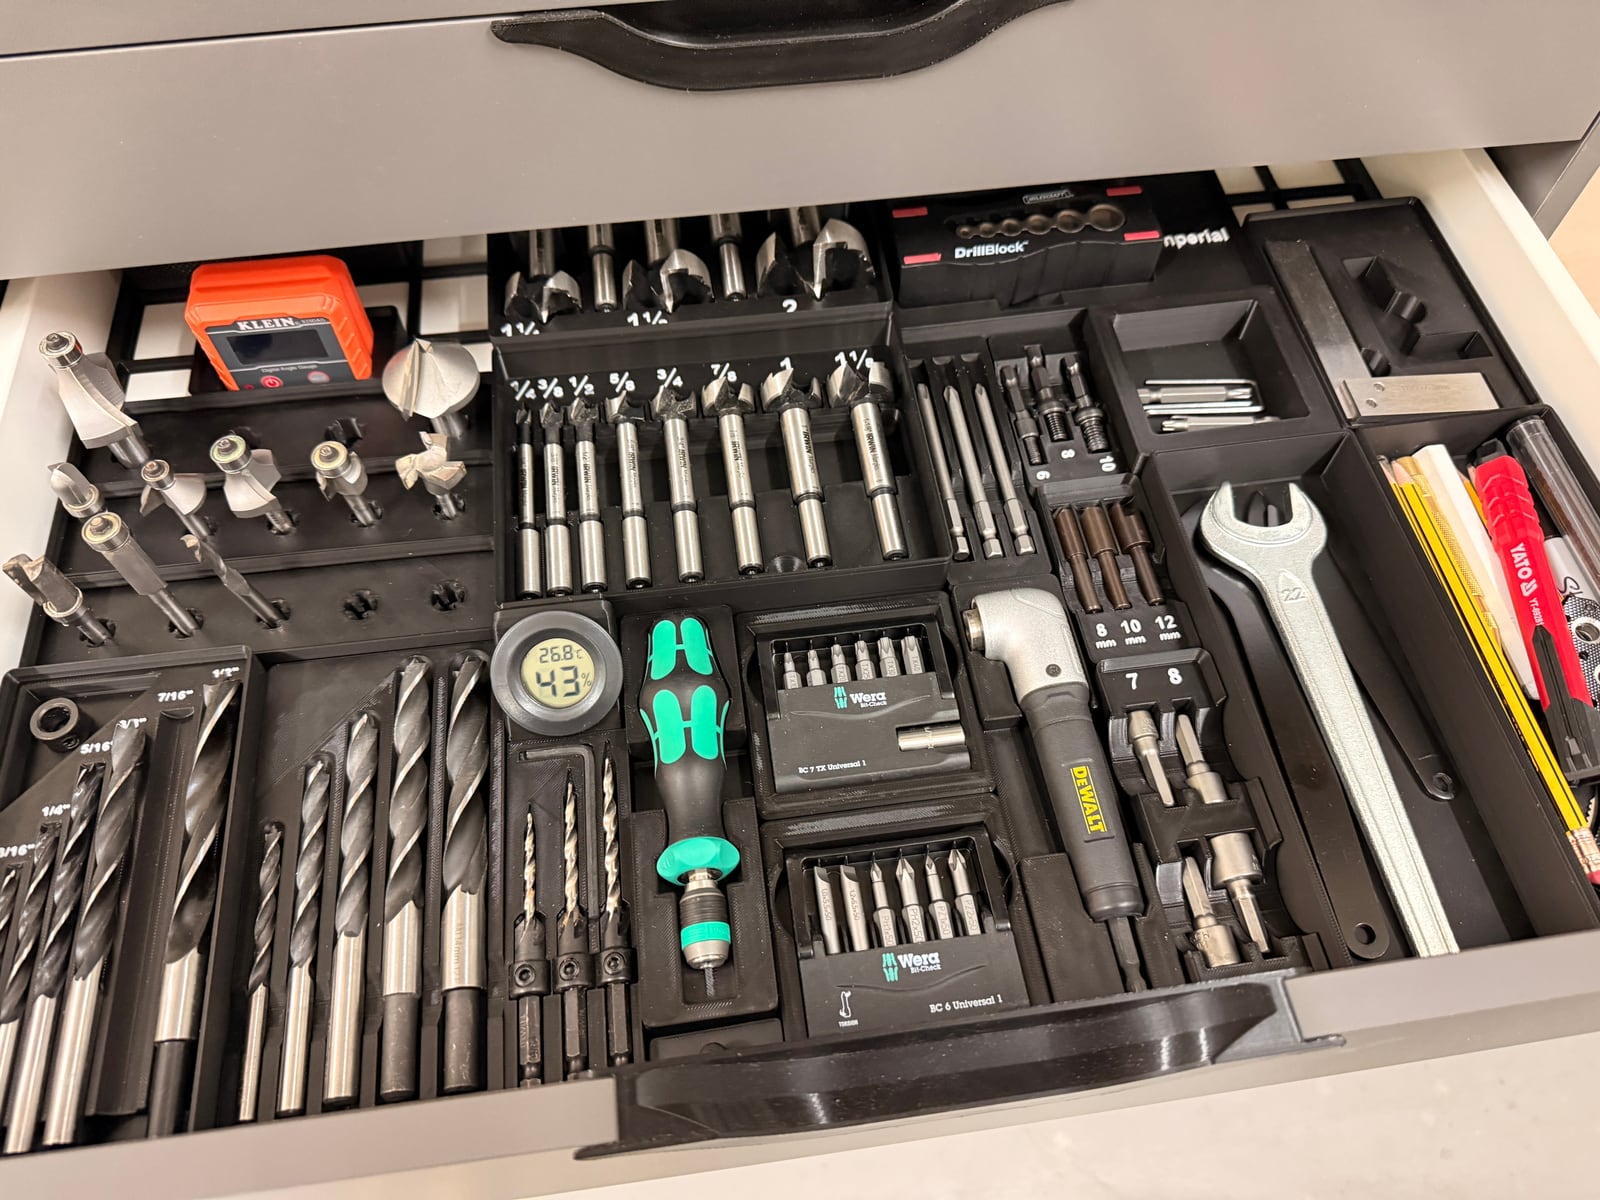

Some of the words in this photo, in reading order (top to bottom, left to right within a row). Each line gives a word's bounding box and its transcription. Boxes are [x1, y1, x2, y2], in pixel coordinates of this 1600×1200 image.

[954, 240, 1025, 259] DrillBlock
[237, 317, 295, 332] KLEIN
[656, 367, 683, 388] 3/4
[710, 362, 738, 383] 7/8
[509, 379, 537, 401] 1/4
[537, 377, 564, 399] 3/8
[568, 375, 595, 396] 1/2
[609, 371, 636, 393] 5/8
[803, 430, 813, 456] IRWIN
[1061, 448, 1076, 459] 8
[1099, 455, 1116, 472] 10
[1510, 542, 1533, 580] YATO
[1095, 623, 1108, 638] 8
[1120, 619, 1142, 634] 10
[1154, 615, 1178, 630] 12
[1095, 639, 1117, 649] mm
[1125, 635, 1147, 645] mm
[1159, 631, 1182, 641] mm
[1125, 672, 1138, 690] 7
[1167, 667, 1183, 685] 8
[849, 691, 887, 704] Wera
[827, 760, 861, 771] Universal
[1072, 765, 1106, 833] DEWALT
[897, 951, 941, 969] Wera
[910, 963, 942, 974] Bit-Check
[929, 1003, 944, 1014] BC
[944, 1002, 952, 1011] 6
[952, 995, 996, 1010] Universal
[997, 994, 1003, 1003] 1
